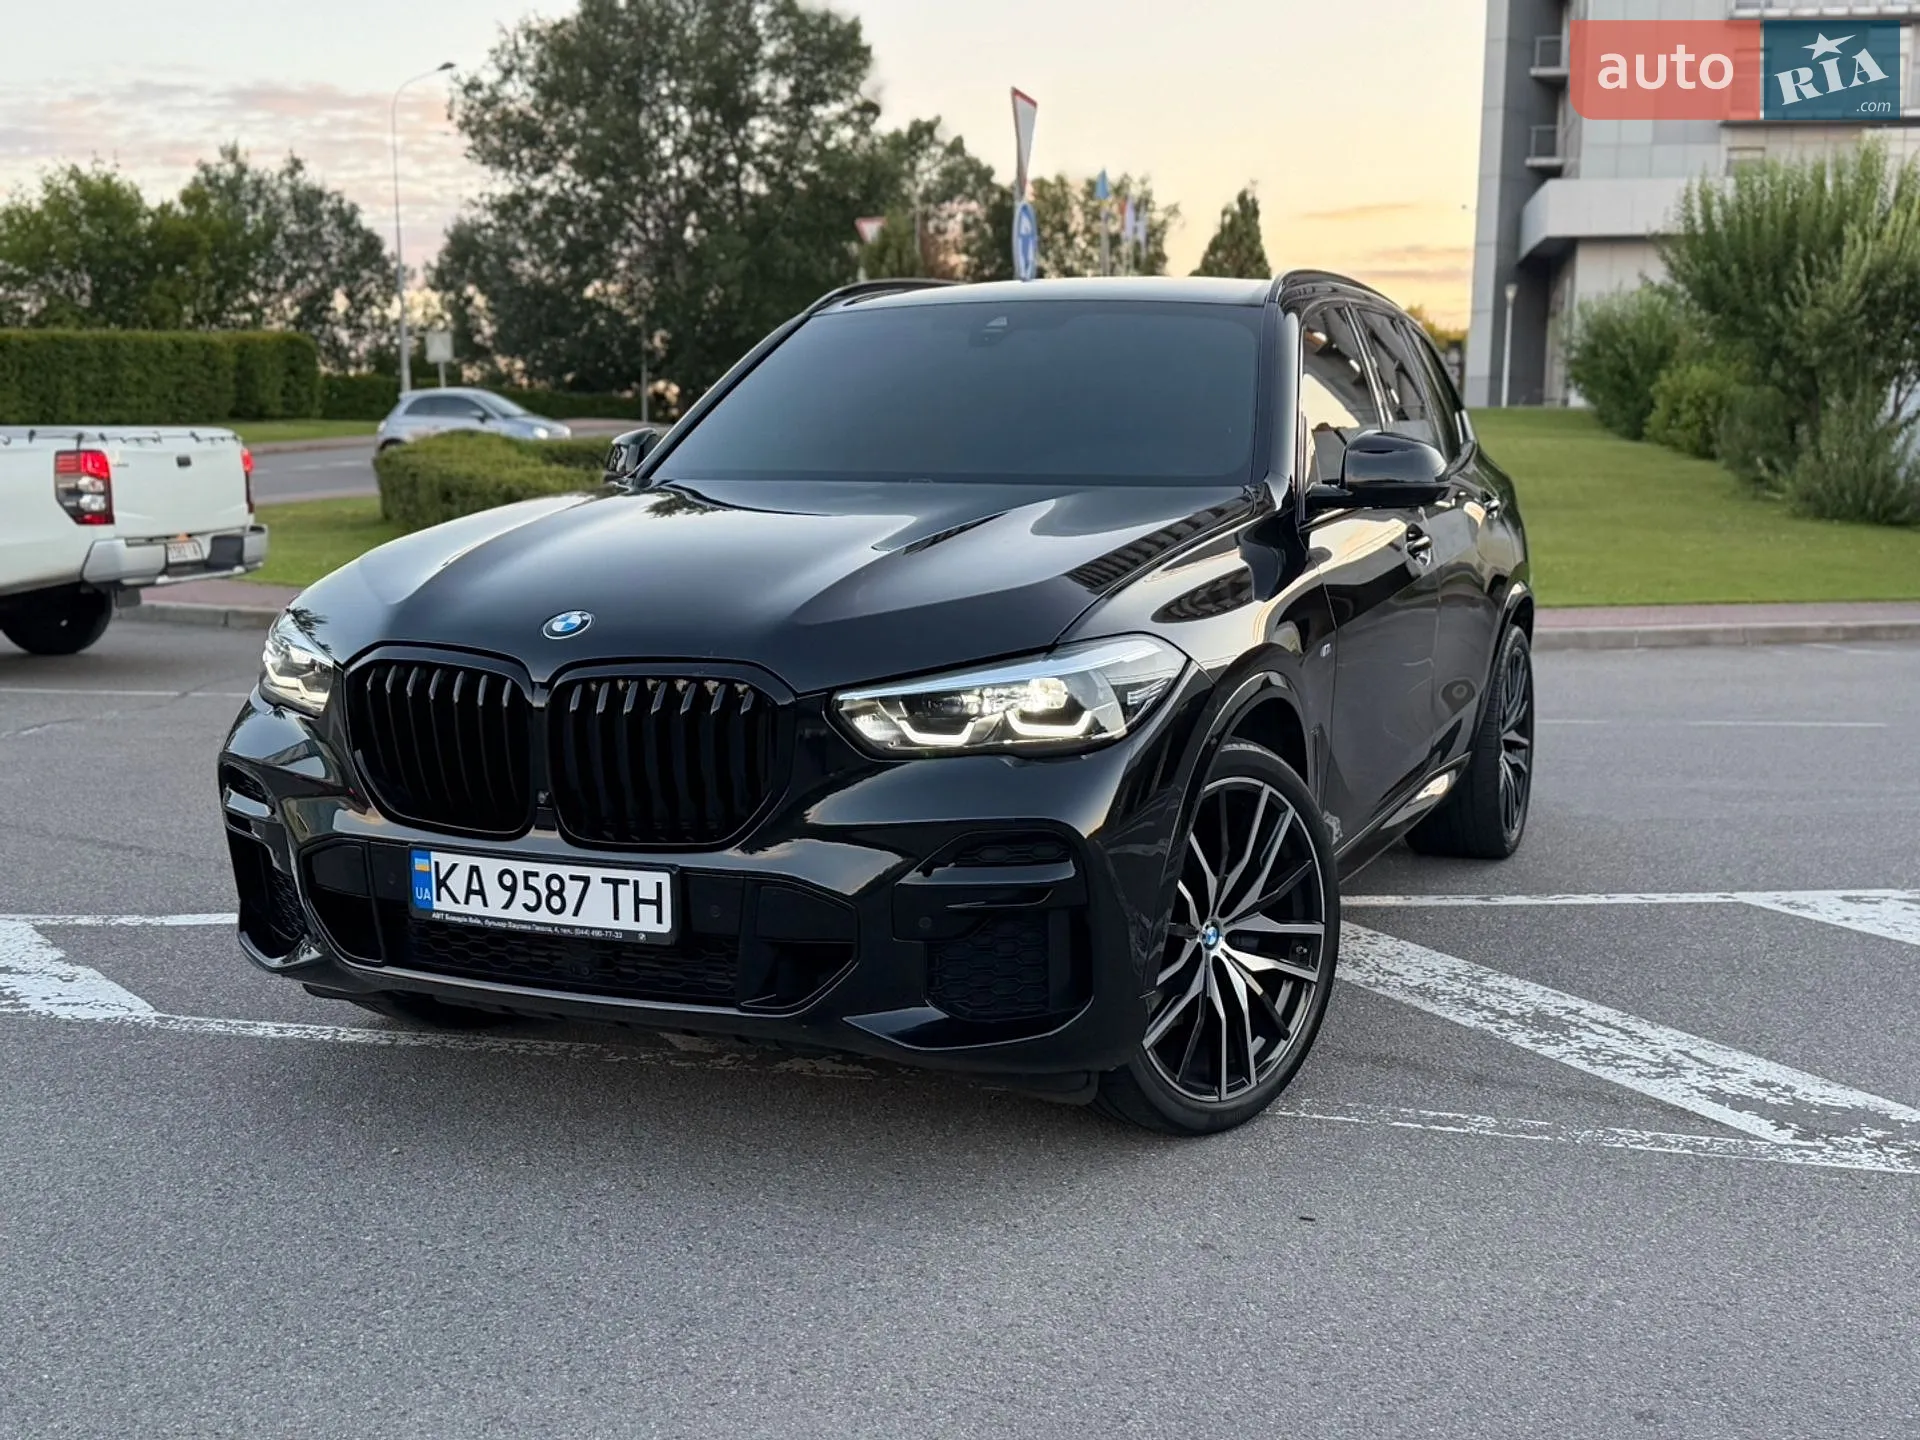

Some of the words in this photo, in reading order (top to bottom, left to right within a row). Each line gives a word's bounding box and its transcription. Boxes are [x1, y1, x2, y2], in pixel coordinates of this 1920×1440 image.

[415, 886, 432, 901] UA
[434, 861, 489, 908] KA
[497, 867, 591, 917] 9587
[601, 877, 663, 925] TH
